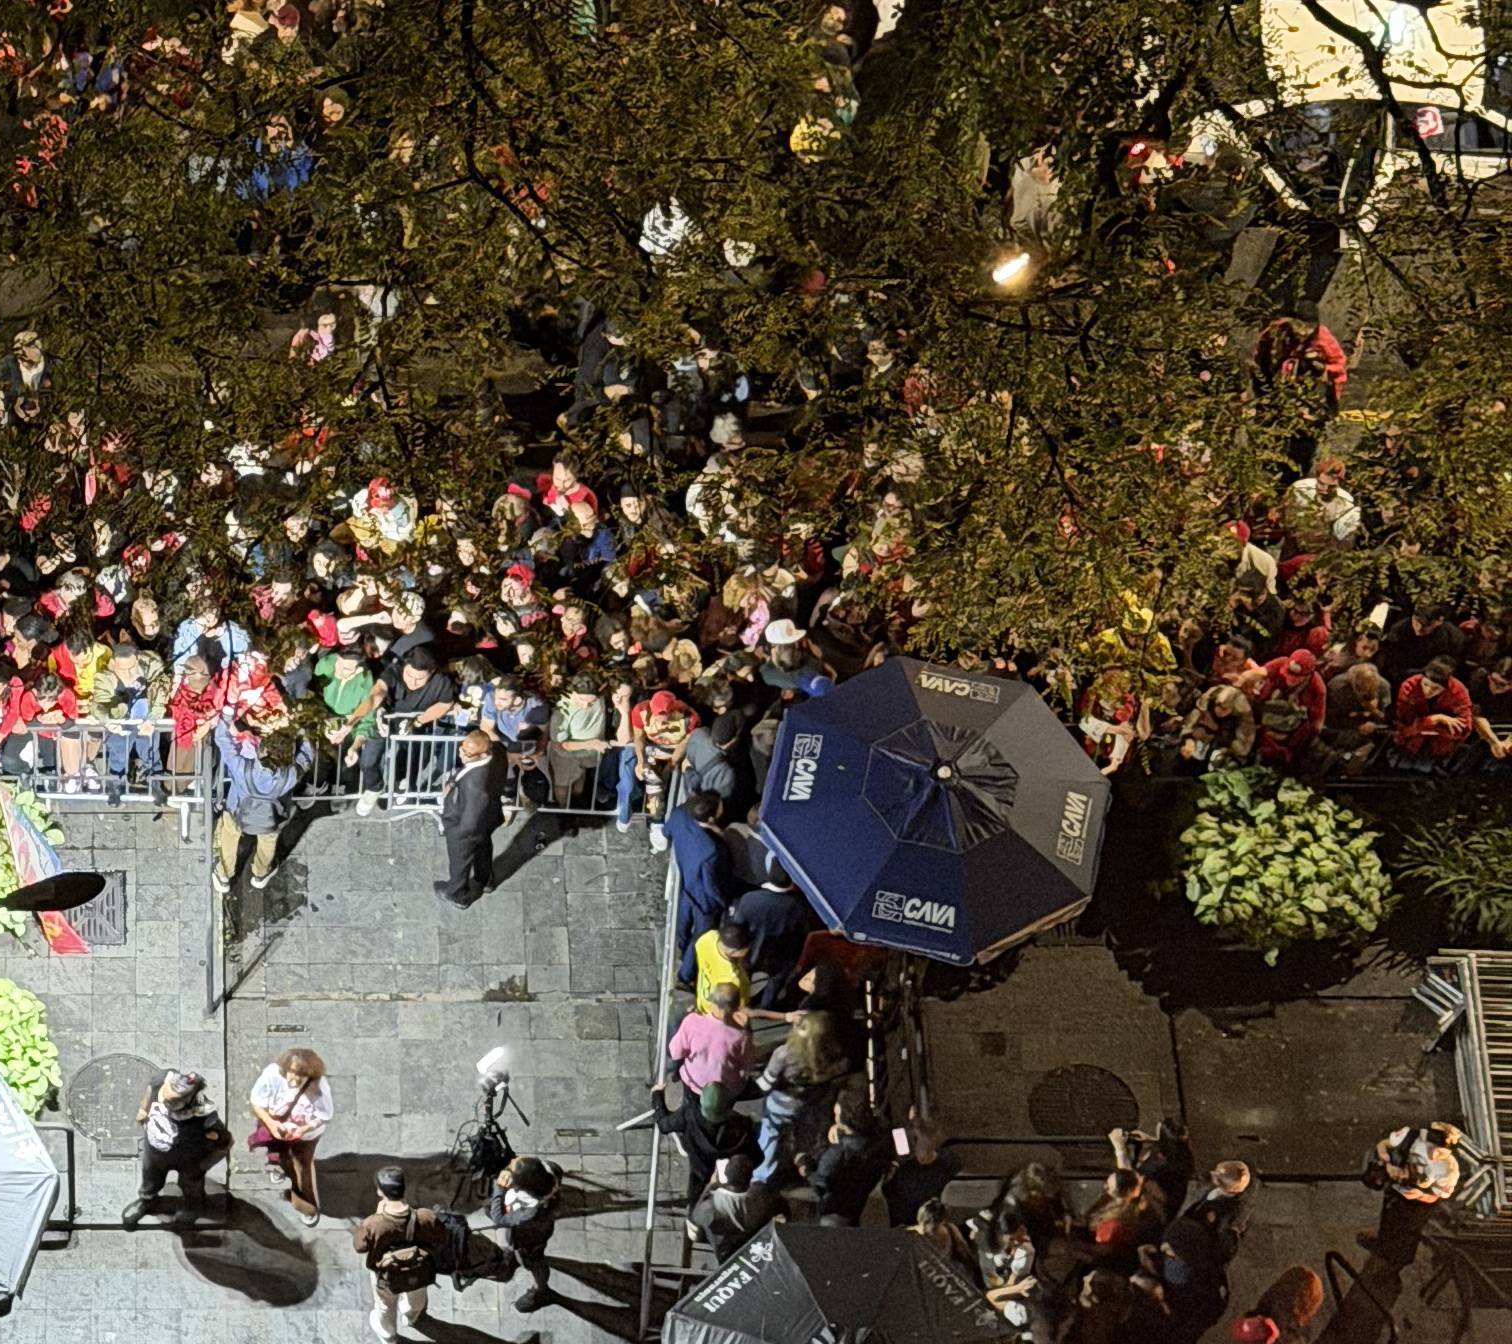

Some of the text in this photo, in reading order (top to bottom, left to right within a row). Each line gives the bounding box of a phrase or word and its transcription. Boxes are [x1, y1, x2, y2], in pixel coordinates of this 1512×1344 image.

[920, 674, 970, 696] CAVA
[789, 759, 817, 800] CAVA
[1061, 791, 1088, 837] CAVA
[904, 898, 956, 928] CAVA
[702, 1270, 753, 1313] FAQUI
